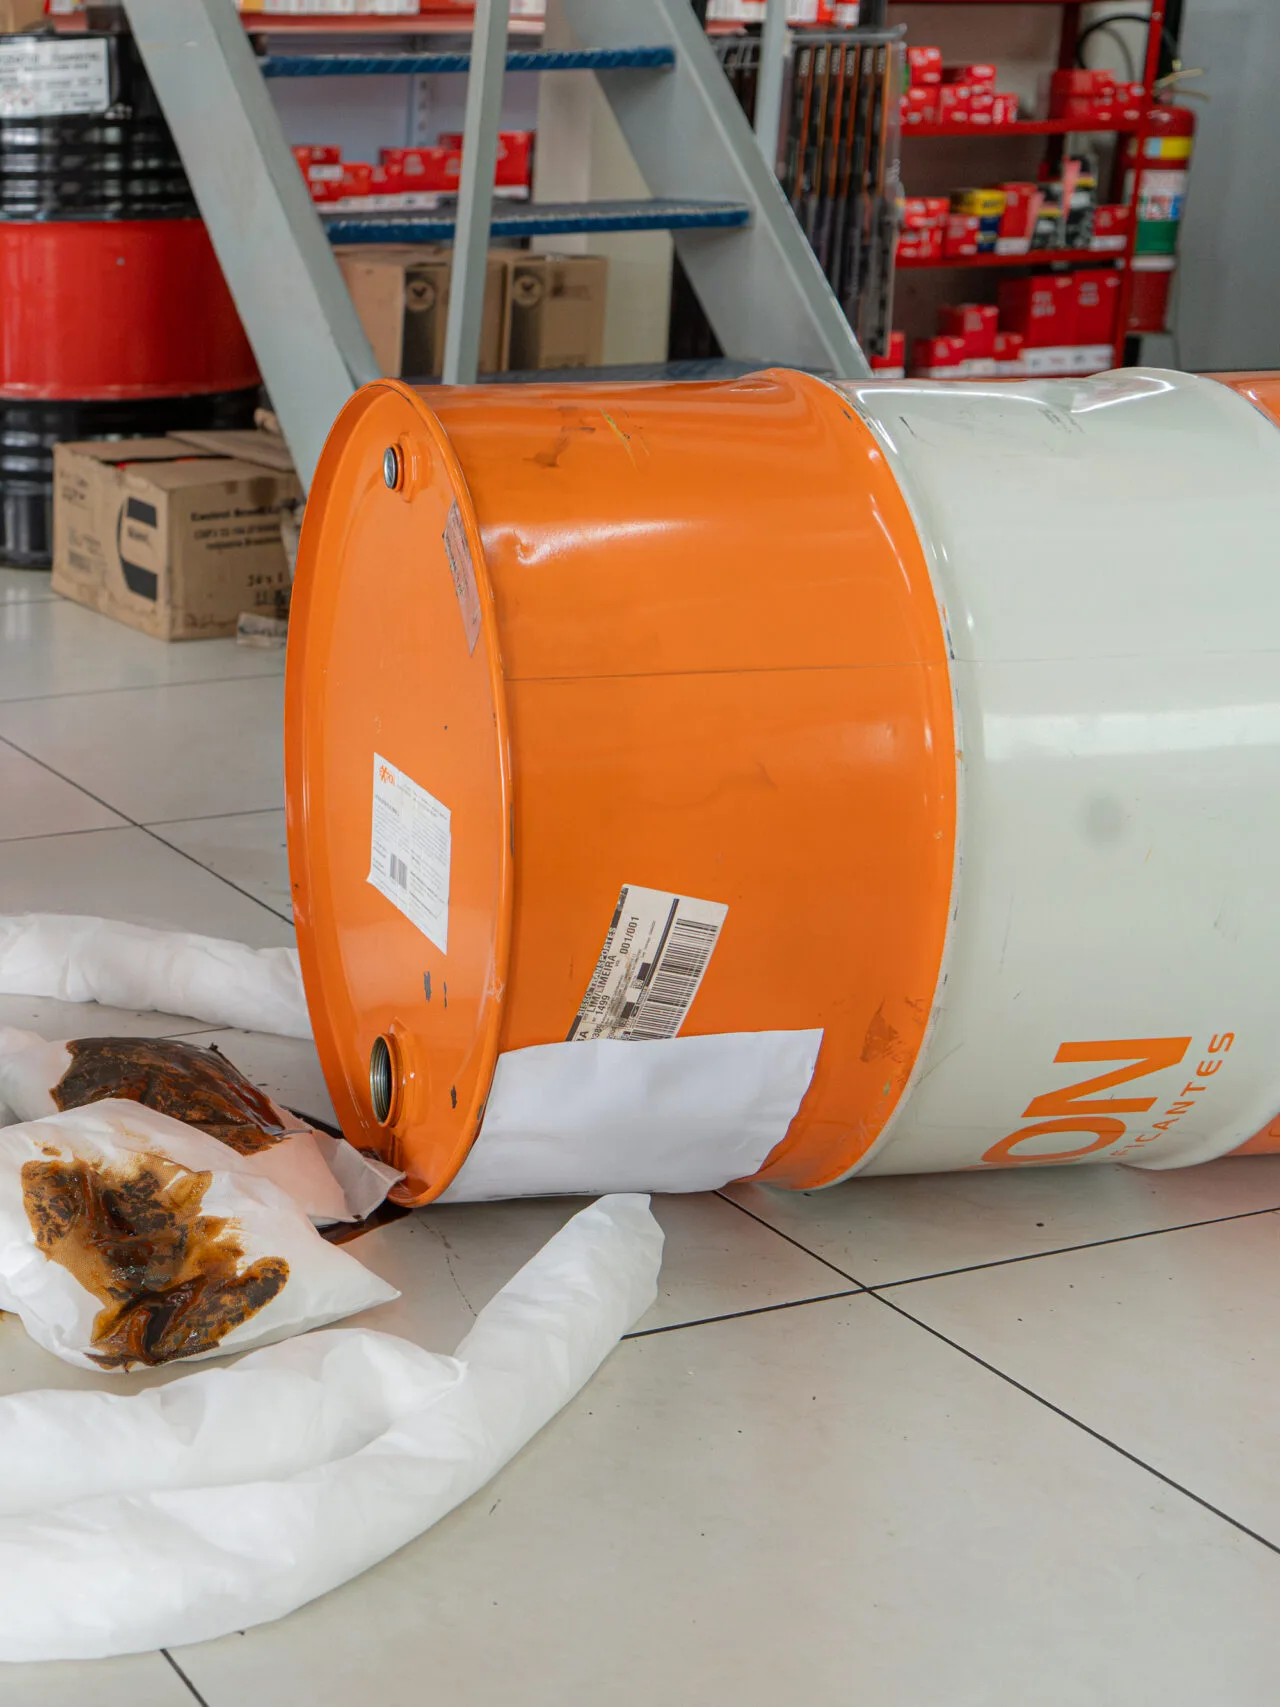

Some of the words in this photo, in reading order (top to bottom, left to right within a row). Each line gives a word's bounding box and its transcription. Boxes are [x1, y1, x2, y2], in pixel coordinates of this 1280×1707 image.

[619, 915, 640, 955] 001/001
[586, 955, 617, 1014] LIM/LIMEIRA
[595, 994, 611, 1015] 1499
[978, 1035, 1193, 1164] ON
